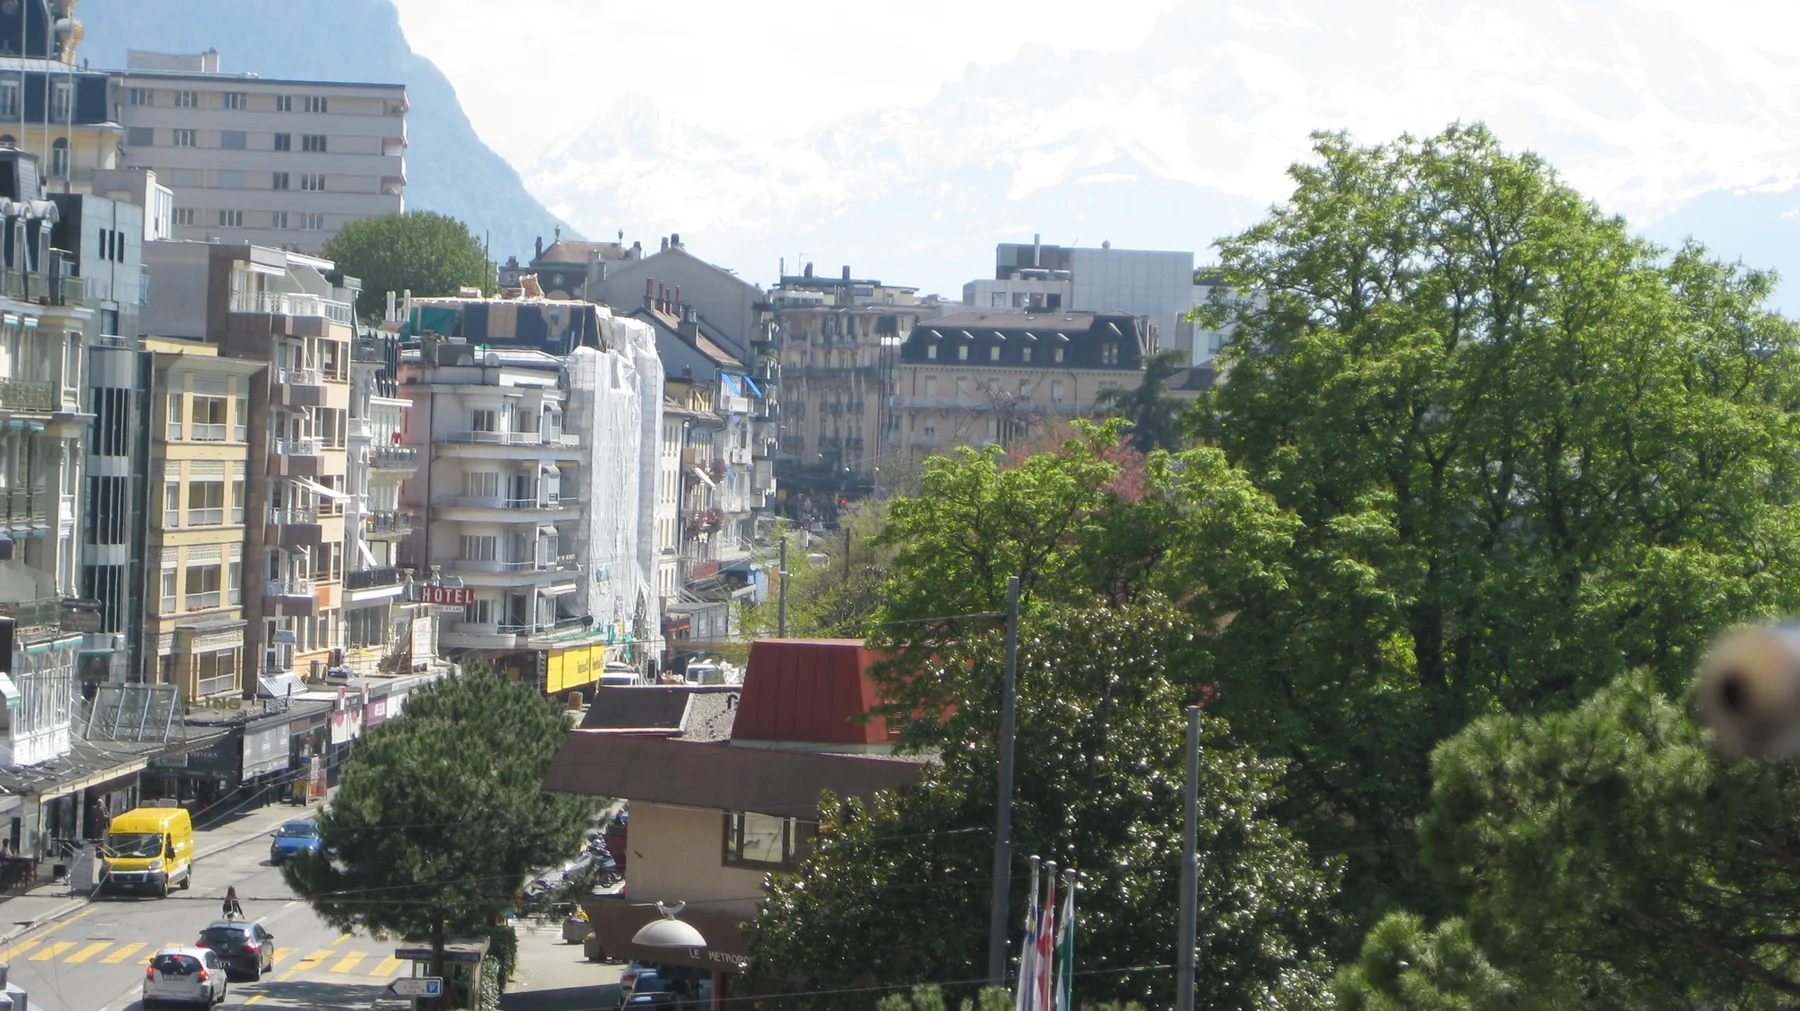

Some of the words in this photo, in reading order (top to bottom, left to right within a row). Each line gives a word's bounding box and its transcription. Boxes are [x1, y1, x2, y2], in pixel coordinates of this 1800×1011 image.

[422, 587, 472, 604] HOTEL
[689, 948, 701, 960] LE
[708, 951, 753, 966] METROPO
